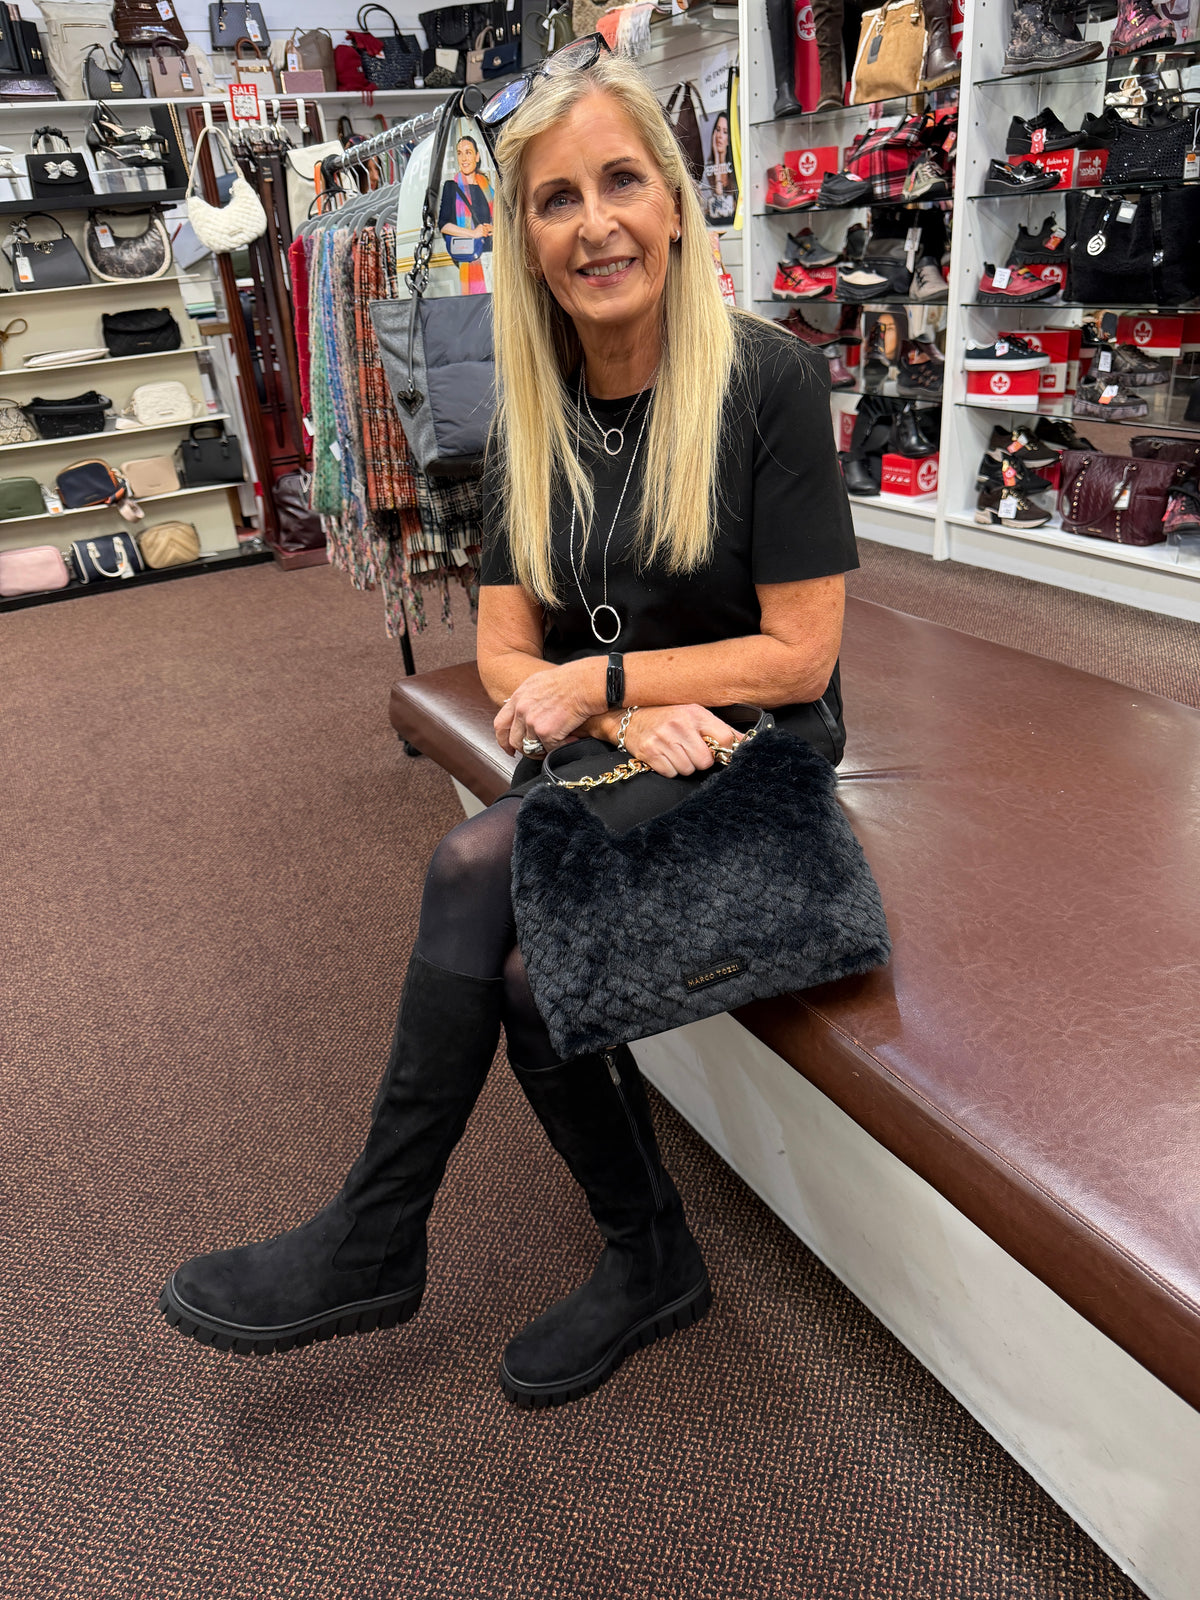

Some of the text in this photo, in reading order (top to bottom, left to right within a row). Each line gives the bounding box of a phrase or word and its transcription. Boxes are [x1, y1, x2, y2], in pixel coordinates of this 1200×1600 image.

[231, 86, 256, 95] SALE
[687, 964, 740, 987] MARCO TOZZI
